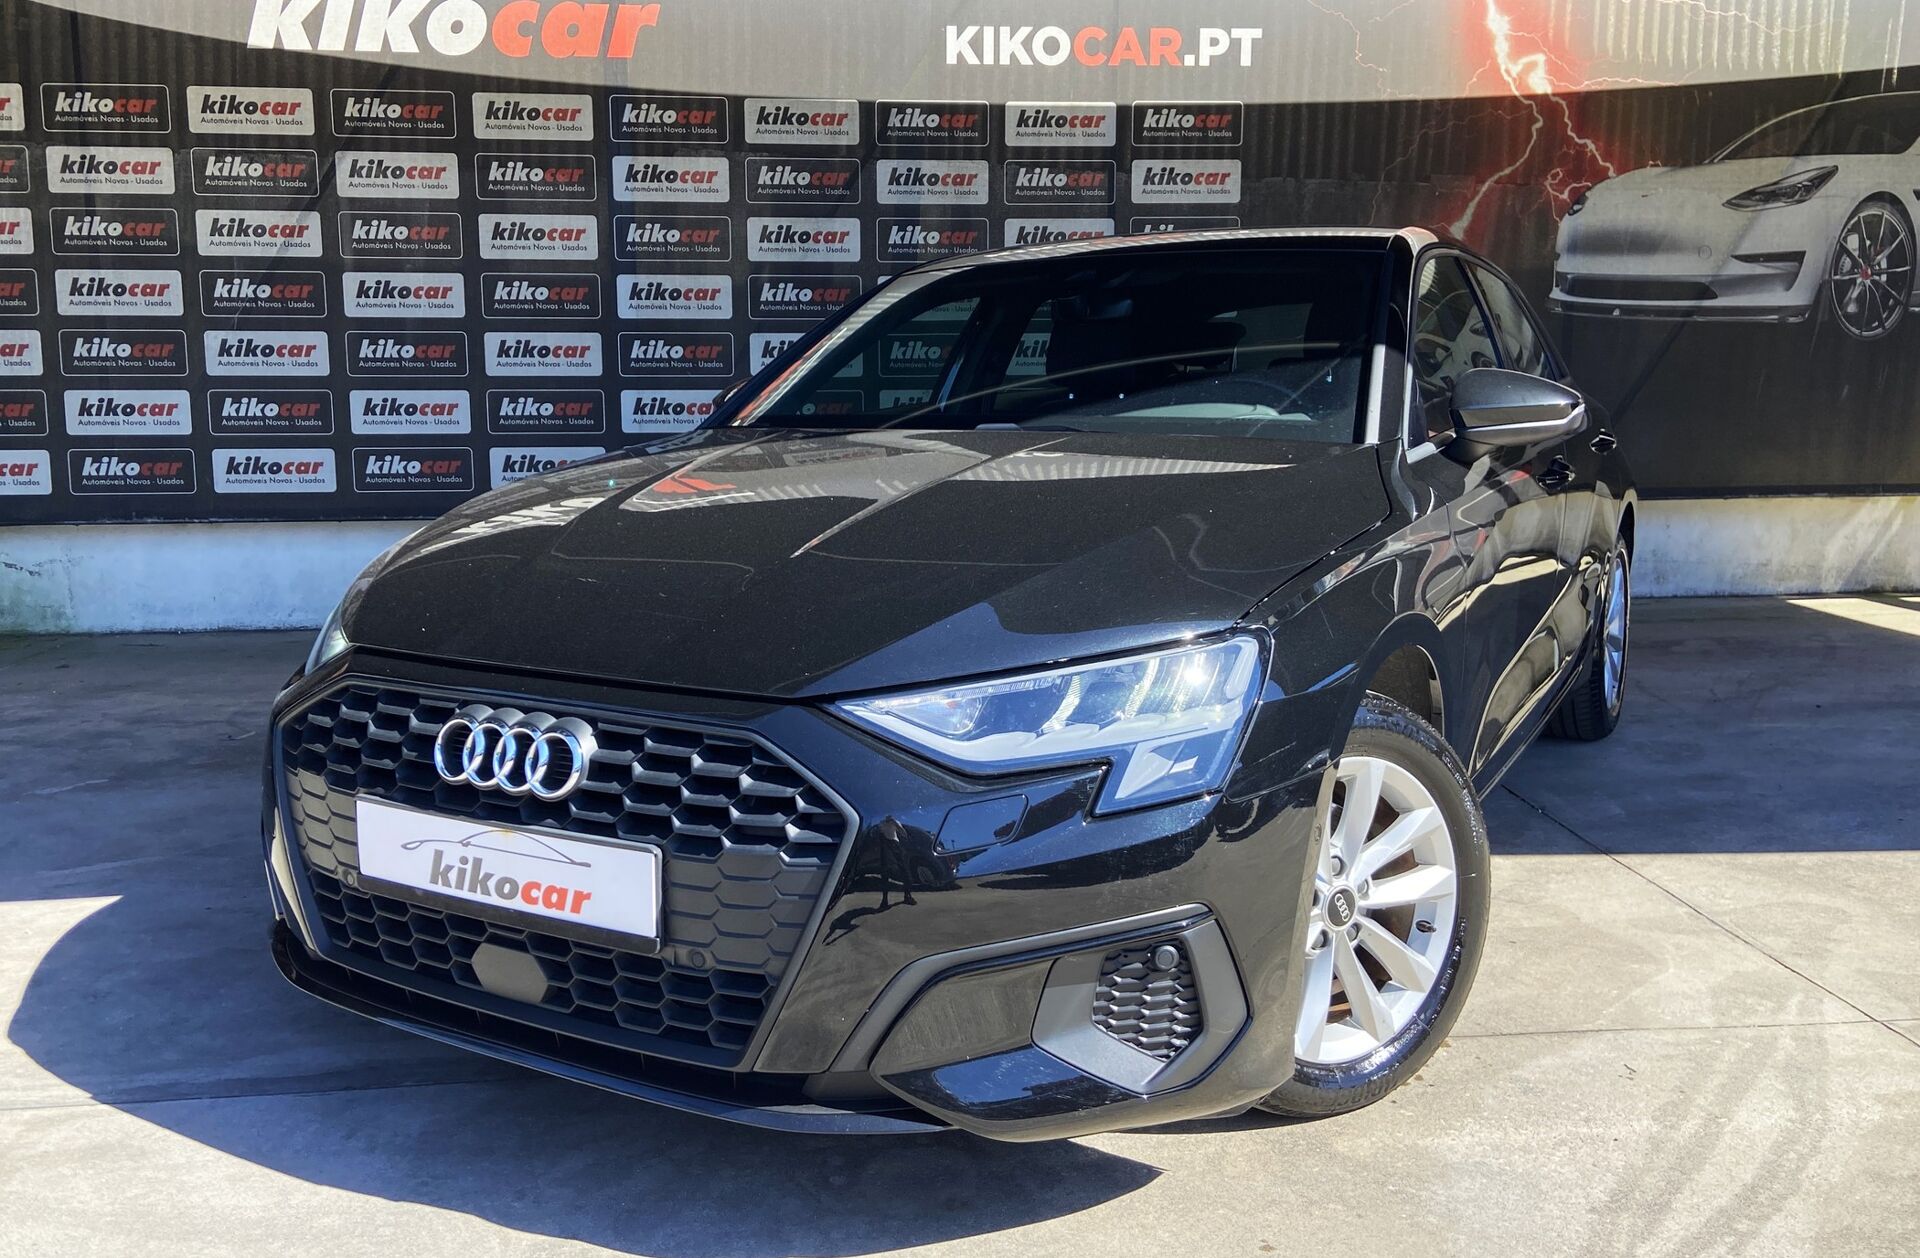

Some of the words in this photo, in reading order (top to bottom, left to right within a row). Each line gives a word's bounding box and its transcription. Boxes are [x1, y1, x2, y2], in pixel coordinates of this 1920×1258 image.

[945, 25, 1262, 67] KIKOCAR.PT
[55, 92, 155, 114] kikocar
[200, 94, 301, 116] kikocar
[344, 97, 443, 119] kikocar
[484, 101, 581, 122] kikocar
[622, 103, 716, 124] kikocar
[756, 106, 848, 127] kikocar
[887, 108, 977, 128] kikocar
[1016, 109, 1104, 129] kikocar
[1143, 108, 1231, 129] kikocar
[60, 154, 160, 175] kikocar
[205, 156, 305, 178] kikocar
[348, 159, 447, 180] kikocar
[488, 162, 585, 183] kikocar
[624, 164, 718, 184] kikocar
[757, 166, 848, 186] kikocar
[888, 167, 978, 187] kikocar
[1015, 167, 1104, 188] kikocar
[1142, 167, 1230, 187] kikocar
[64, 216, 165, 236] kikocar
[209, 218, 309, 238] kikocar
[352, 220, 449, 240] kikocar
[490, 222, 586, 242] kikocar
[626, 223, 719, 243] kikocar
[758, 225, 849, 244] kikocar
[888, 225, 977, 245] kikocar
[69, 277, 168, 297] kikocar
[213, 278, 313, 298] kikocar
[355, 280, 452, 300] kikocar
[493, 281, 590, 301] kikocar
[629, 282, 721, 301] kikocar
[760, 283, 850, 302] kikocar
[73, 338, 173, 358] kikocar
[217, 338, 317, 358] kikocar
[358, 339, 456, 359] kikocar
[496, 339, 590, 359] kikocar
[630, 340, 723, 359] kikocar
[77, 398, 177, 417] kikocar
[221, 397, 320, 417] kikocar
[362, 398, 459, 417] kikocar
[499, 397, 593, 416] kikocar
[633, 397, 715, 416] kikoca
[81, 457, 181, 477] kikocar
[225, 456, 324, 476] kikocar
[365, 455, 462, 475] kikocar
[429, 849, 592, 915] kikocar
